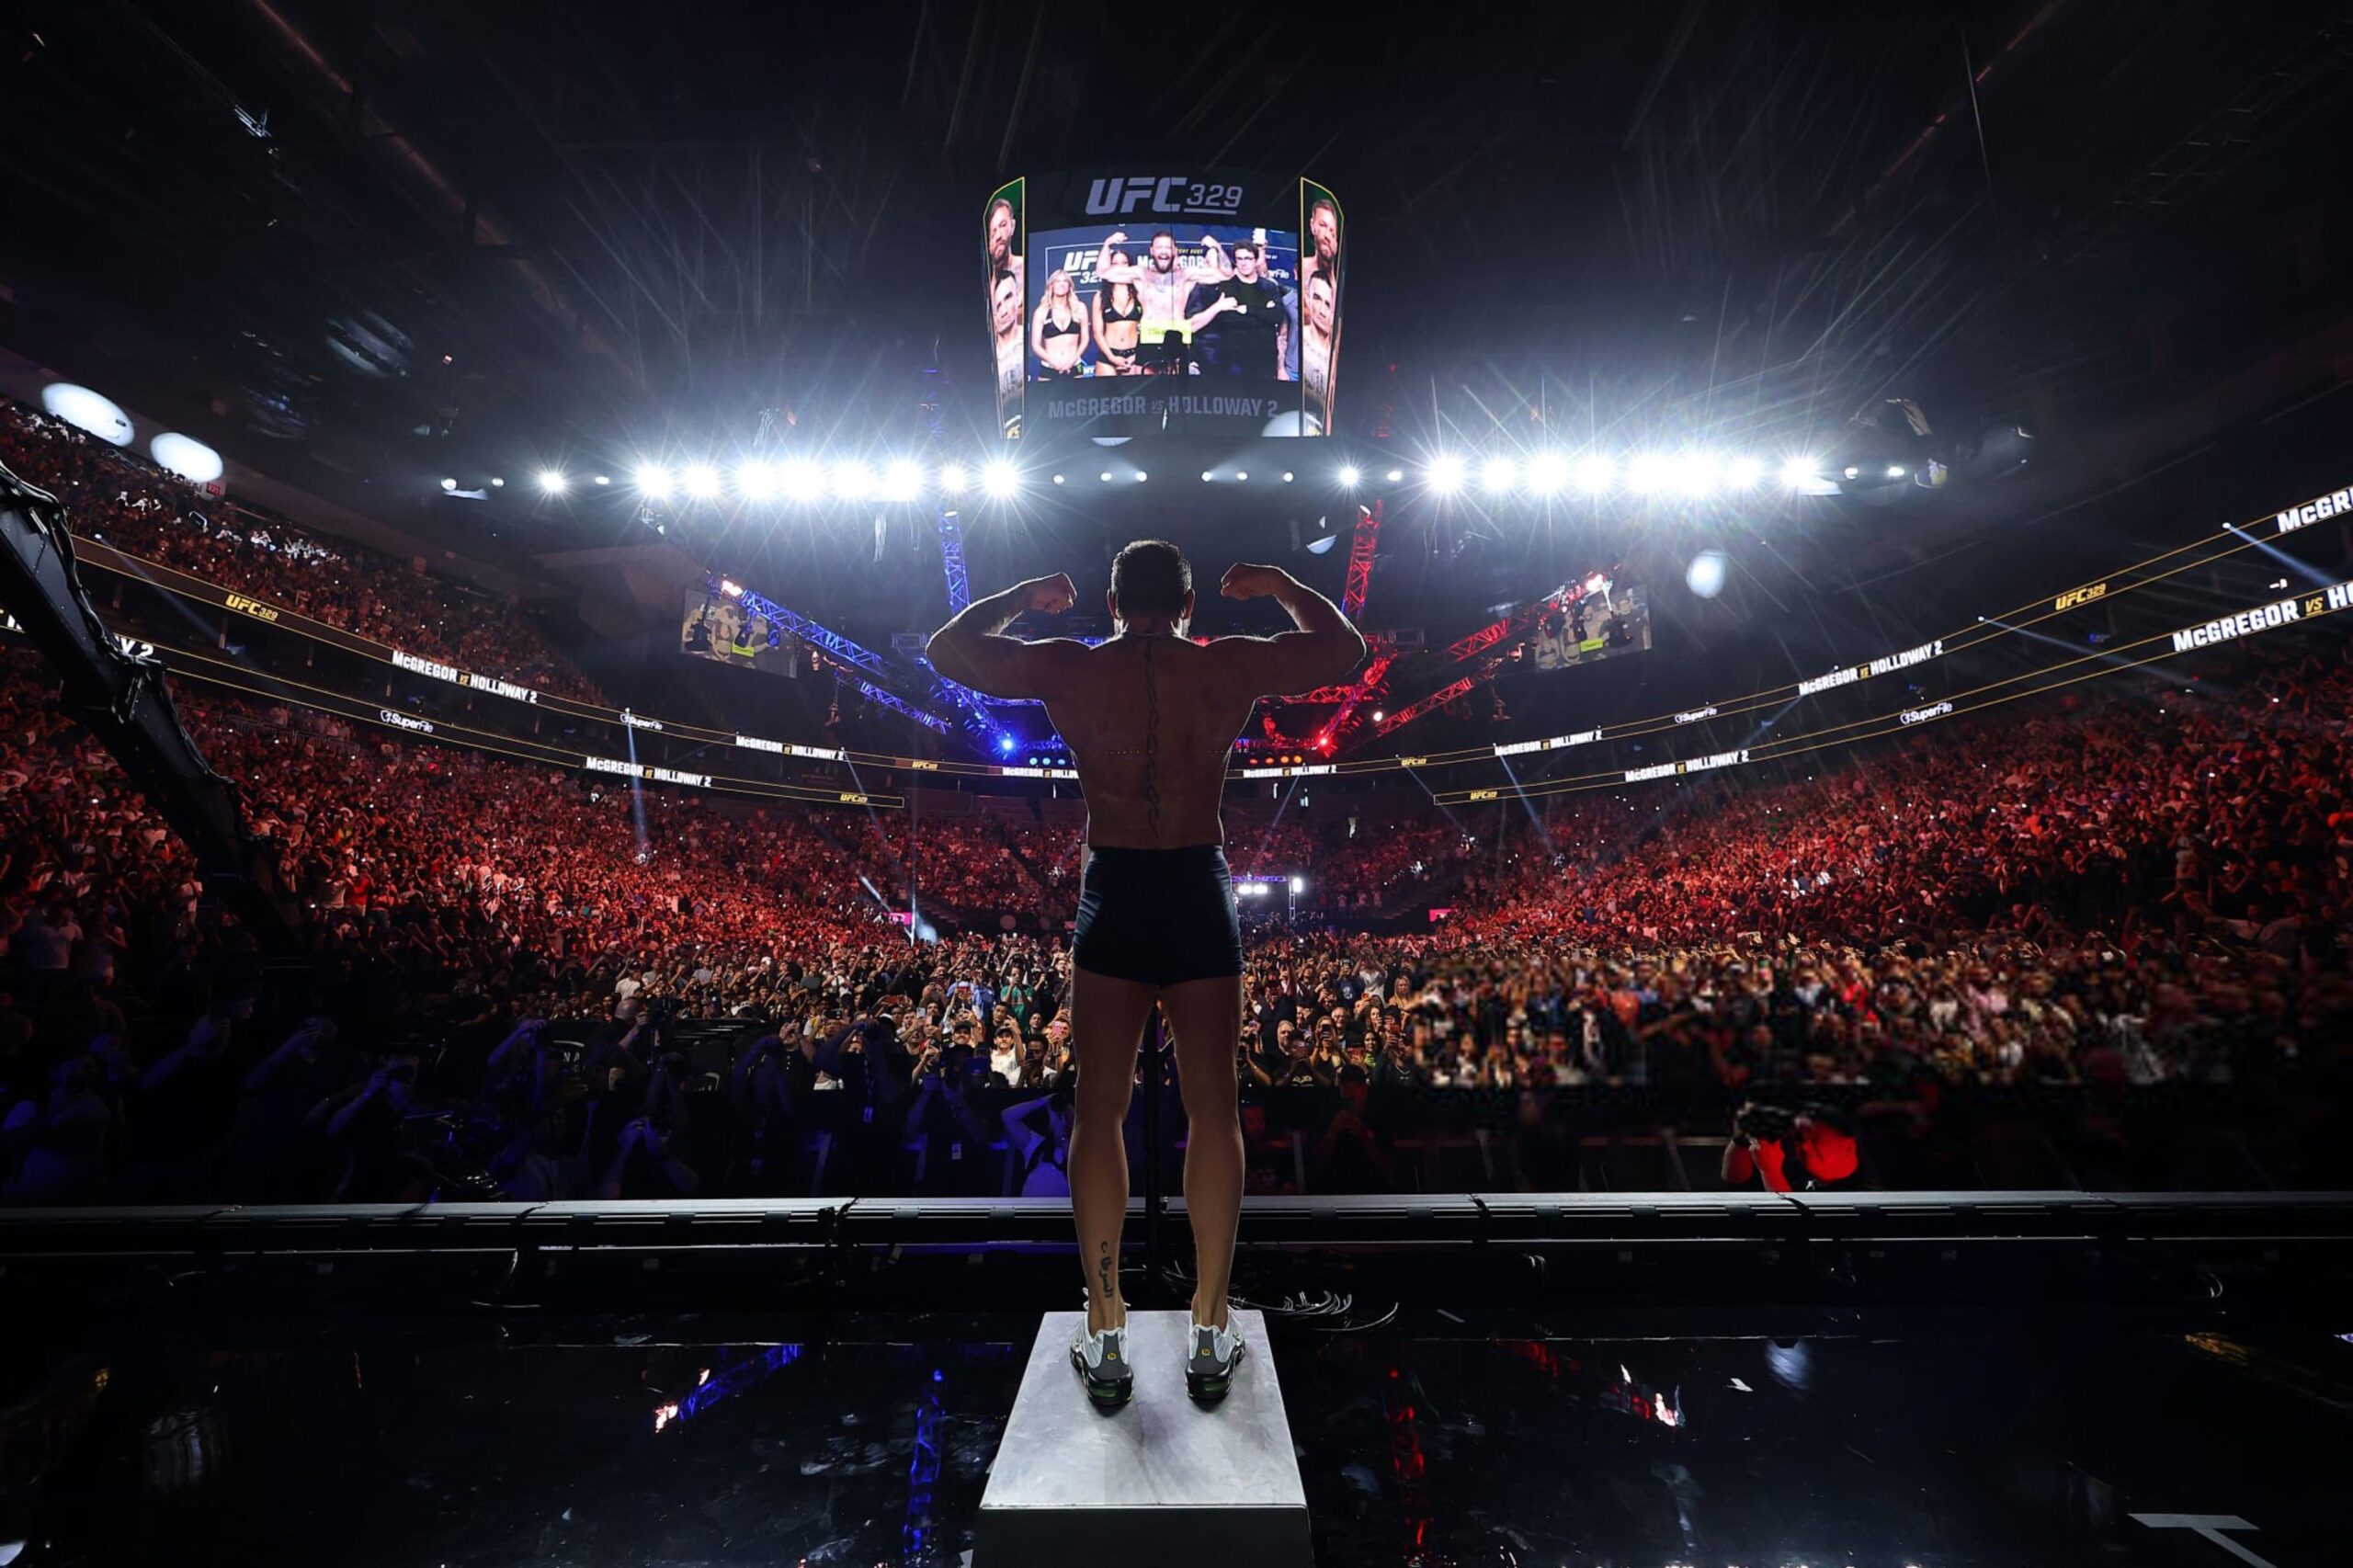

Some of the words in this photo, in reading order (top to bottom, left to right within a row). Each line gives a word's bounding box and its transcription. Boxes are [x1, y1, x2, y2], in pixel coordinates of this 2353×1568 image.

[1086, 177, 1188, 215] UFC
[1186, 184, 1243, 208] 329
[1063, 250, 1099, 270] UF
[1080, 270, 1102, 284] 32
[1048, 396, 1146, 419] McGREGOR
[1168, 395, 1261, 417] HOLLOWAY
[1267, 400, 1278, 418] 2
[2277, 487, 2353, 533] McGR
[225, 594, 261, 616] UFC
[2055, 588, 2086, 610] UFC
[2172, 599, 2299, 653] McGREGOR
[2305, 597, 2324, 614] VS
[392, 651, 458, 682] McGREGOR
[470, 674, 528, 701] HOLLOWAY
[529, 691, 537, 703] 2
[1798, 668, 1859, 696] McGREGOR
[1870, 644, 1932, 676] HOLLOWAY
[1934, 640, 1943, 655] 2
[391, 712, 434, 733] SuperFile
[1909, 702, 1953, 722] SuperFile
[586, 756, 643, 777] McGREGOR
[654, 767, 702, 787] HOLLOWAY
[704, 777, 712, 788] 2
[1624, 764, 1677, 782] McGREGOR
[1686, 751, 1739, 772] HOLLOWAY
[1740, 750, 1749, 762] 2
